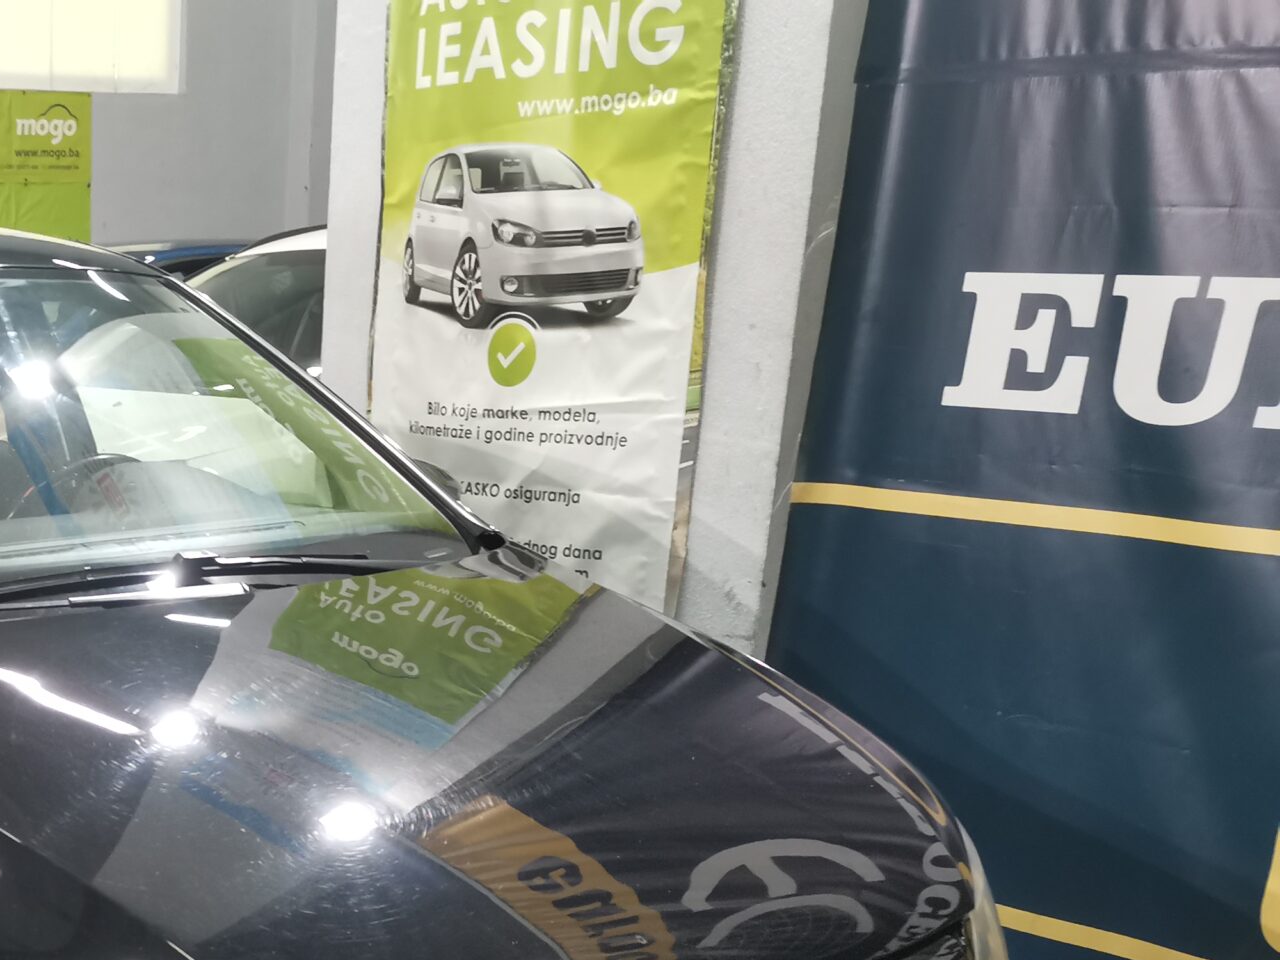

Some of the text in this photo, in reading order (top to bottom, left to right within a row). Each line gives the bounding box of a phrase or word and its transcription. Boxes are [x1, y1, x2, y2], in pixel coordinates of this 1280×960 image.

[415, 0, 685, 89] LEASING
[518, 84, 678, 118] www.mogo.ba
[16, 118, 77, 145] mogo
[15, 148, 79, 160] www.mogo.ba
[941, 271, 1280, 429] EU
[428, 401, 601, 425] Bilo koje marke, modela,
[409, 420, 628, 450] kilometraže i godine proizvodnje
[504, 487, 581, 507] osiguranja
[563, 543, 603, 561] dana
